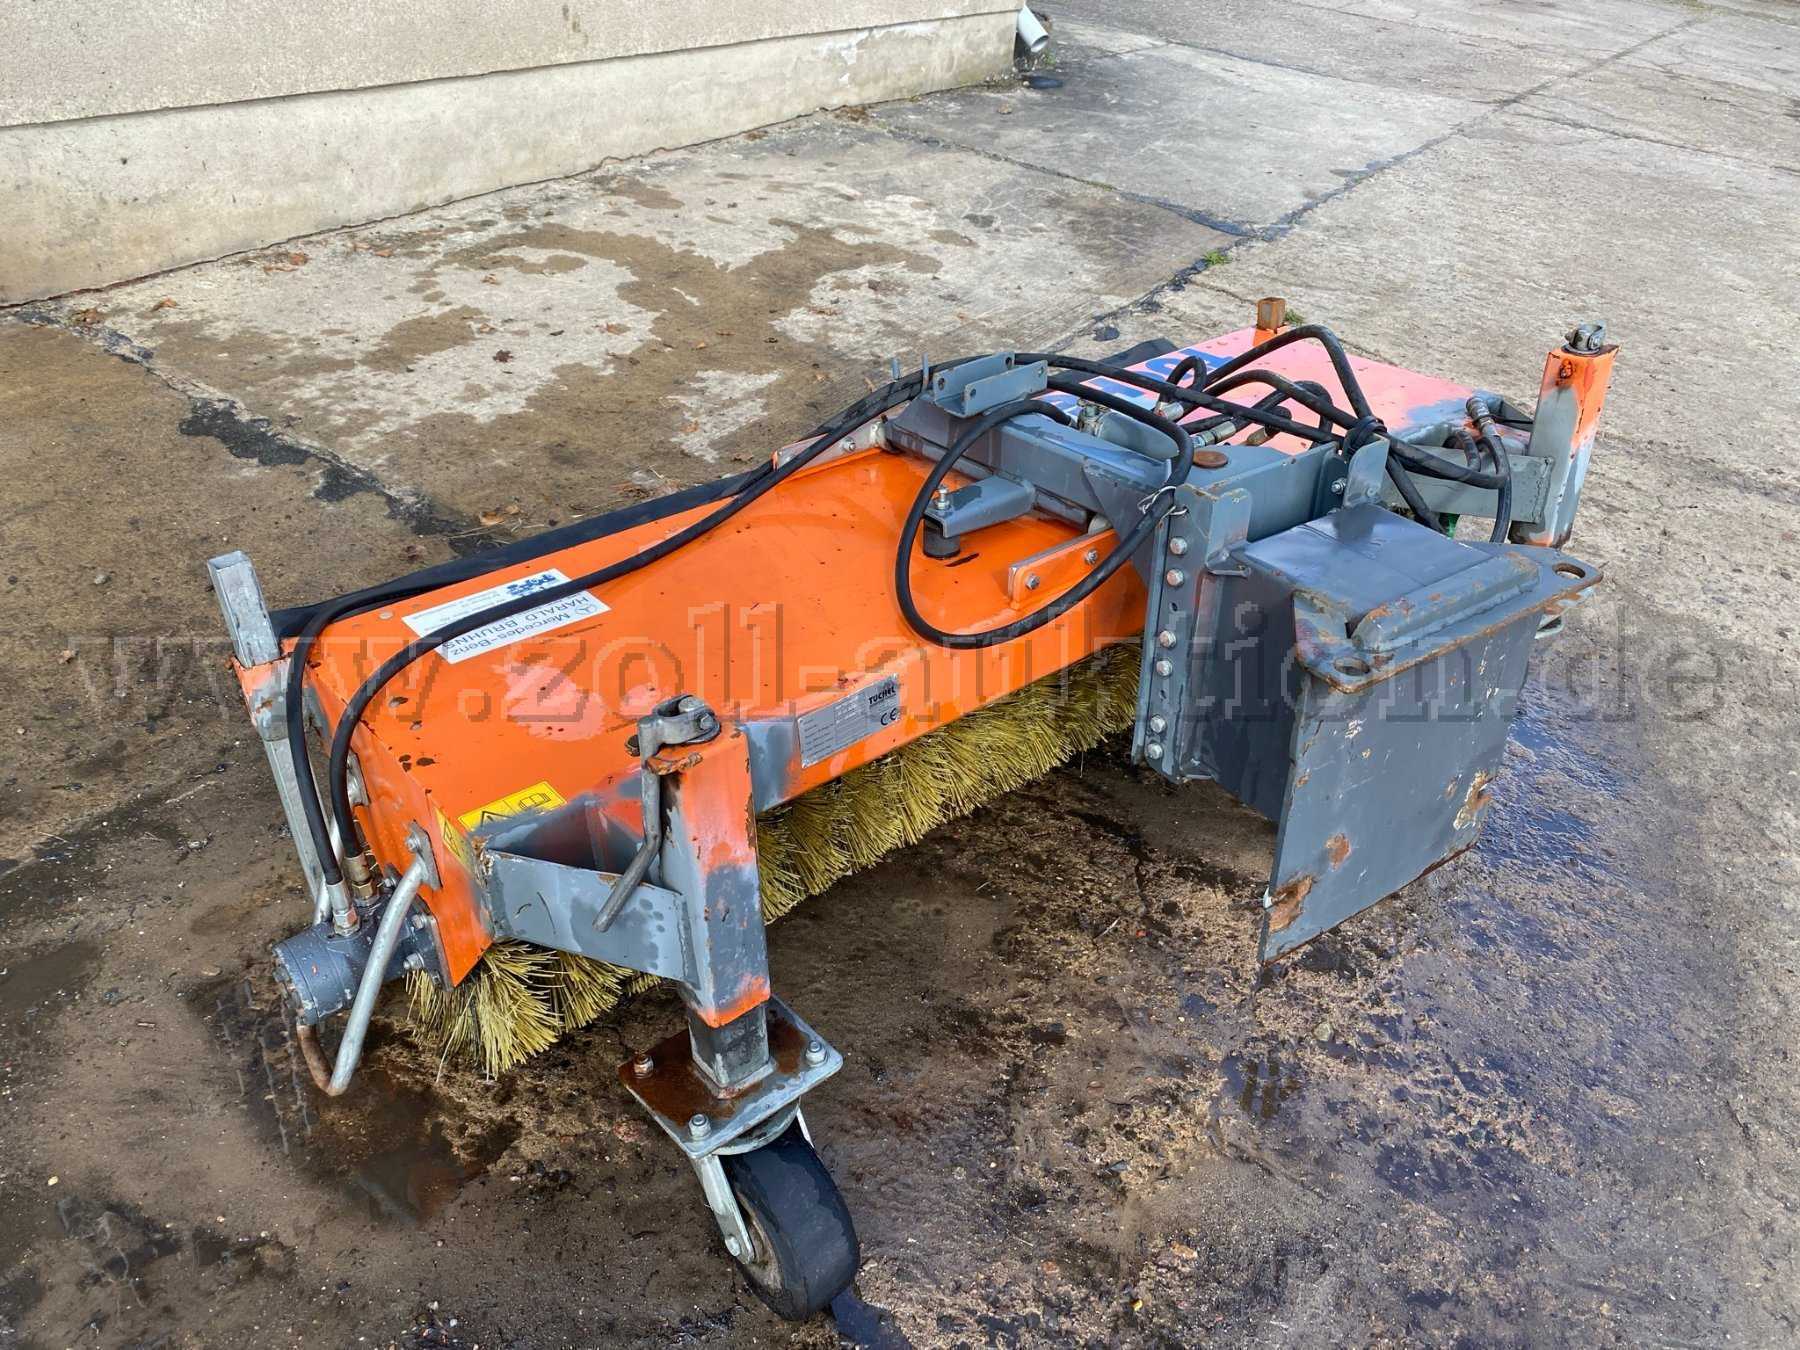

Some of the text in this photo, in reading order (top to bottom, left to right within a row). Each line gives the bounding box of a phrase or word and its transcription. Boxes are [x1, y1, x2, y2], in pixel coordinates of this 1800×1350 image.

[525, 596, 589, 624] HARALD
[442, 618, 519, 650] BRUHNS
[452, 612, 571, 656] Mercedes-Benz
[868, 685, 896, 704] TUCHEL
[880, 707, 897, 726] CE
